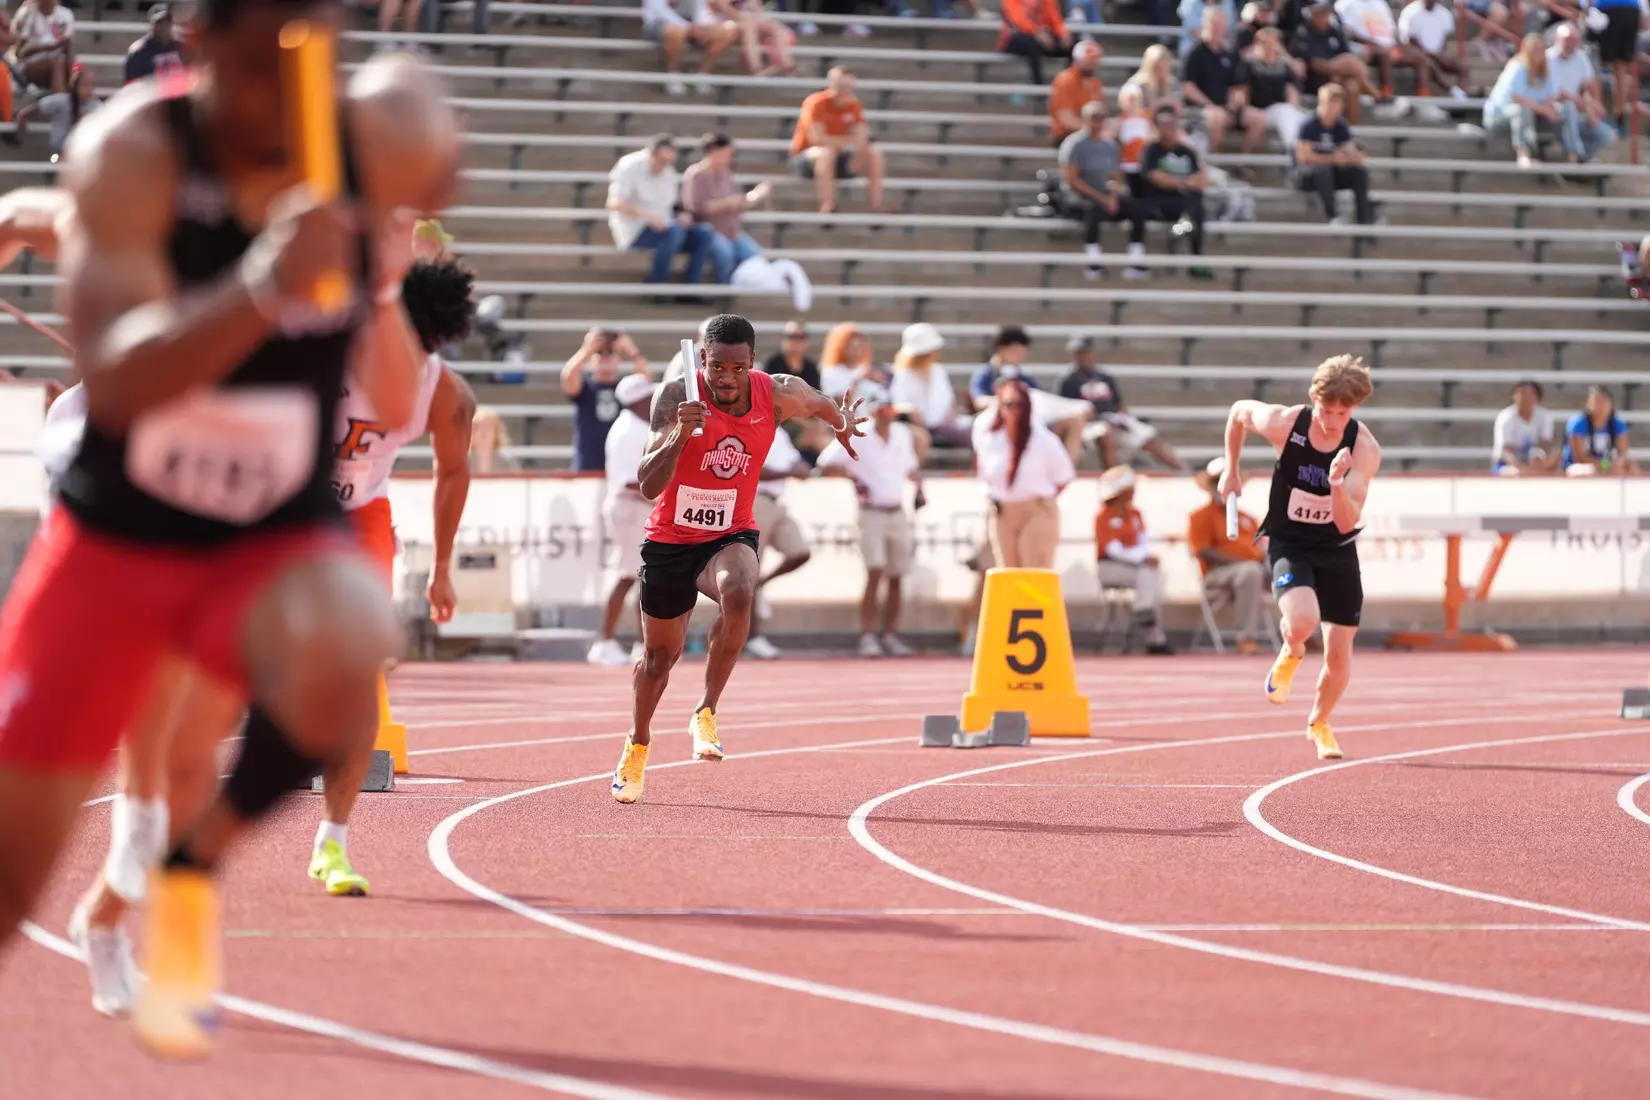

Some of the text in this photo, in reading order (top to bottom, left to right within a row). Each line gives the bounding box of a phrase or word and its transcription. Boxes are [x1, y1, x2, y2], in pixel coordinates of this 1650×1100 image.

[682, 508, 725, 526] 4491
[1294, 507, 1332, 521] 4147
[1005, 609, 1047, 675] 5
[1006, 681, 1044, 691] UCS
